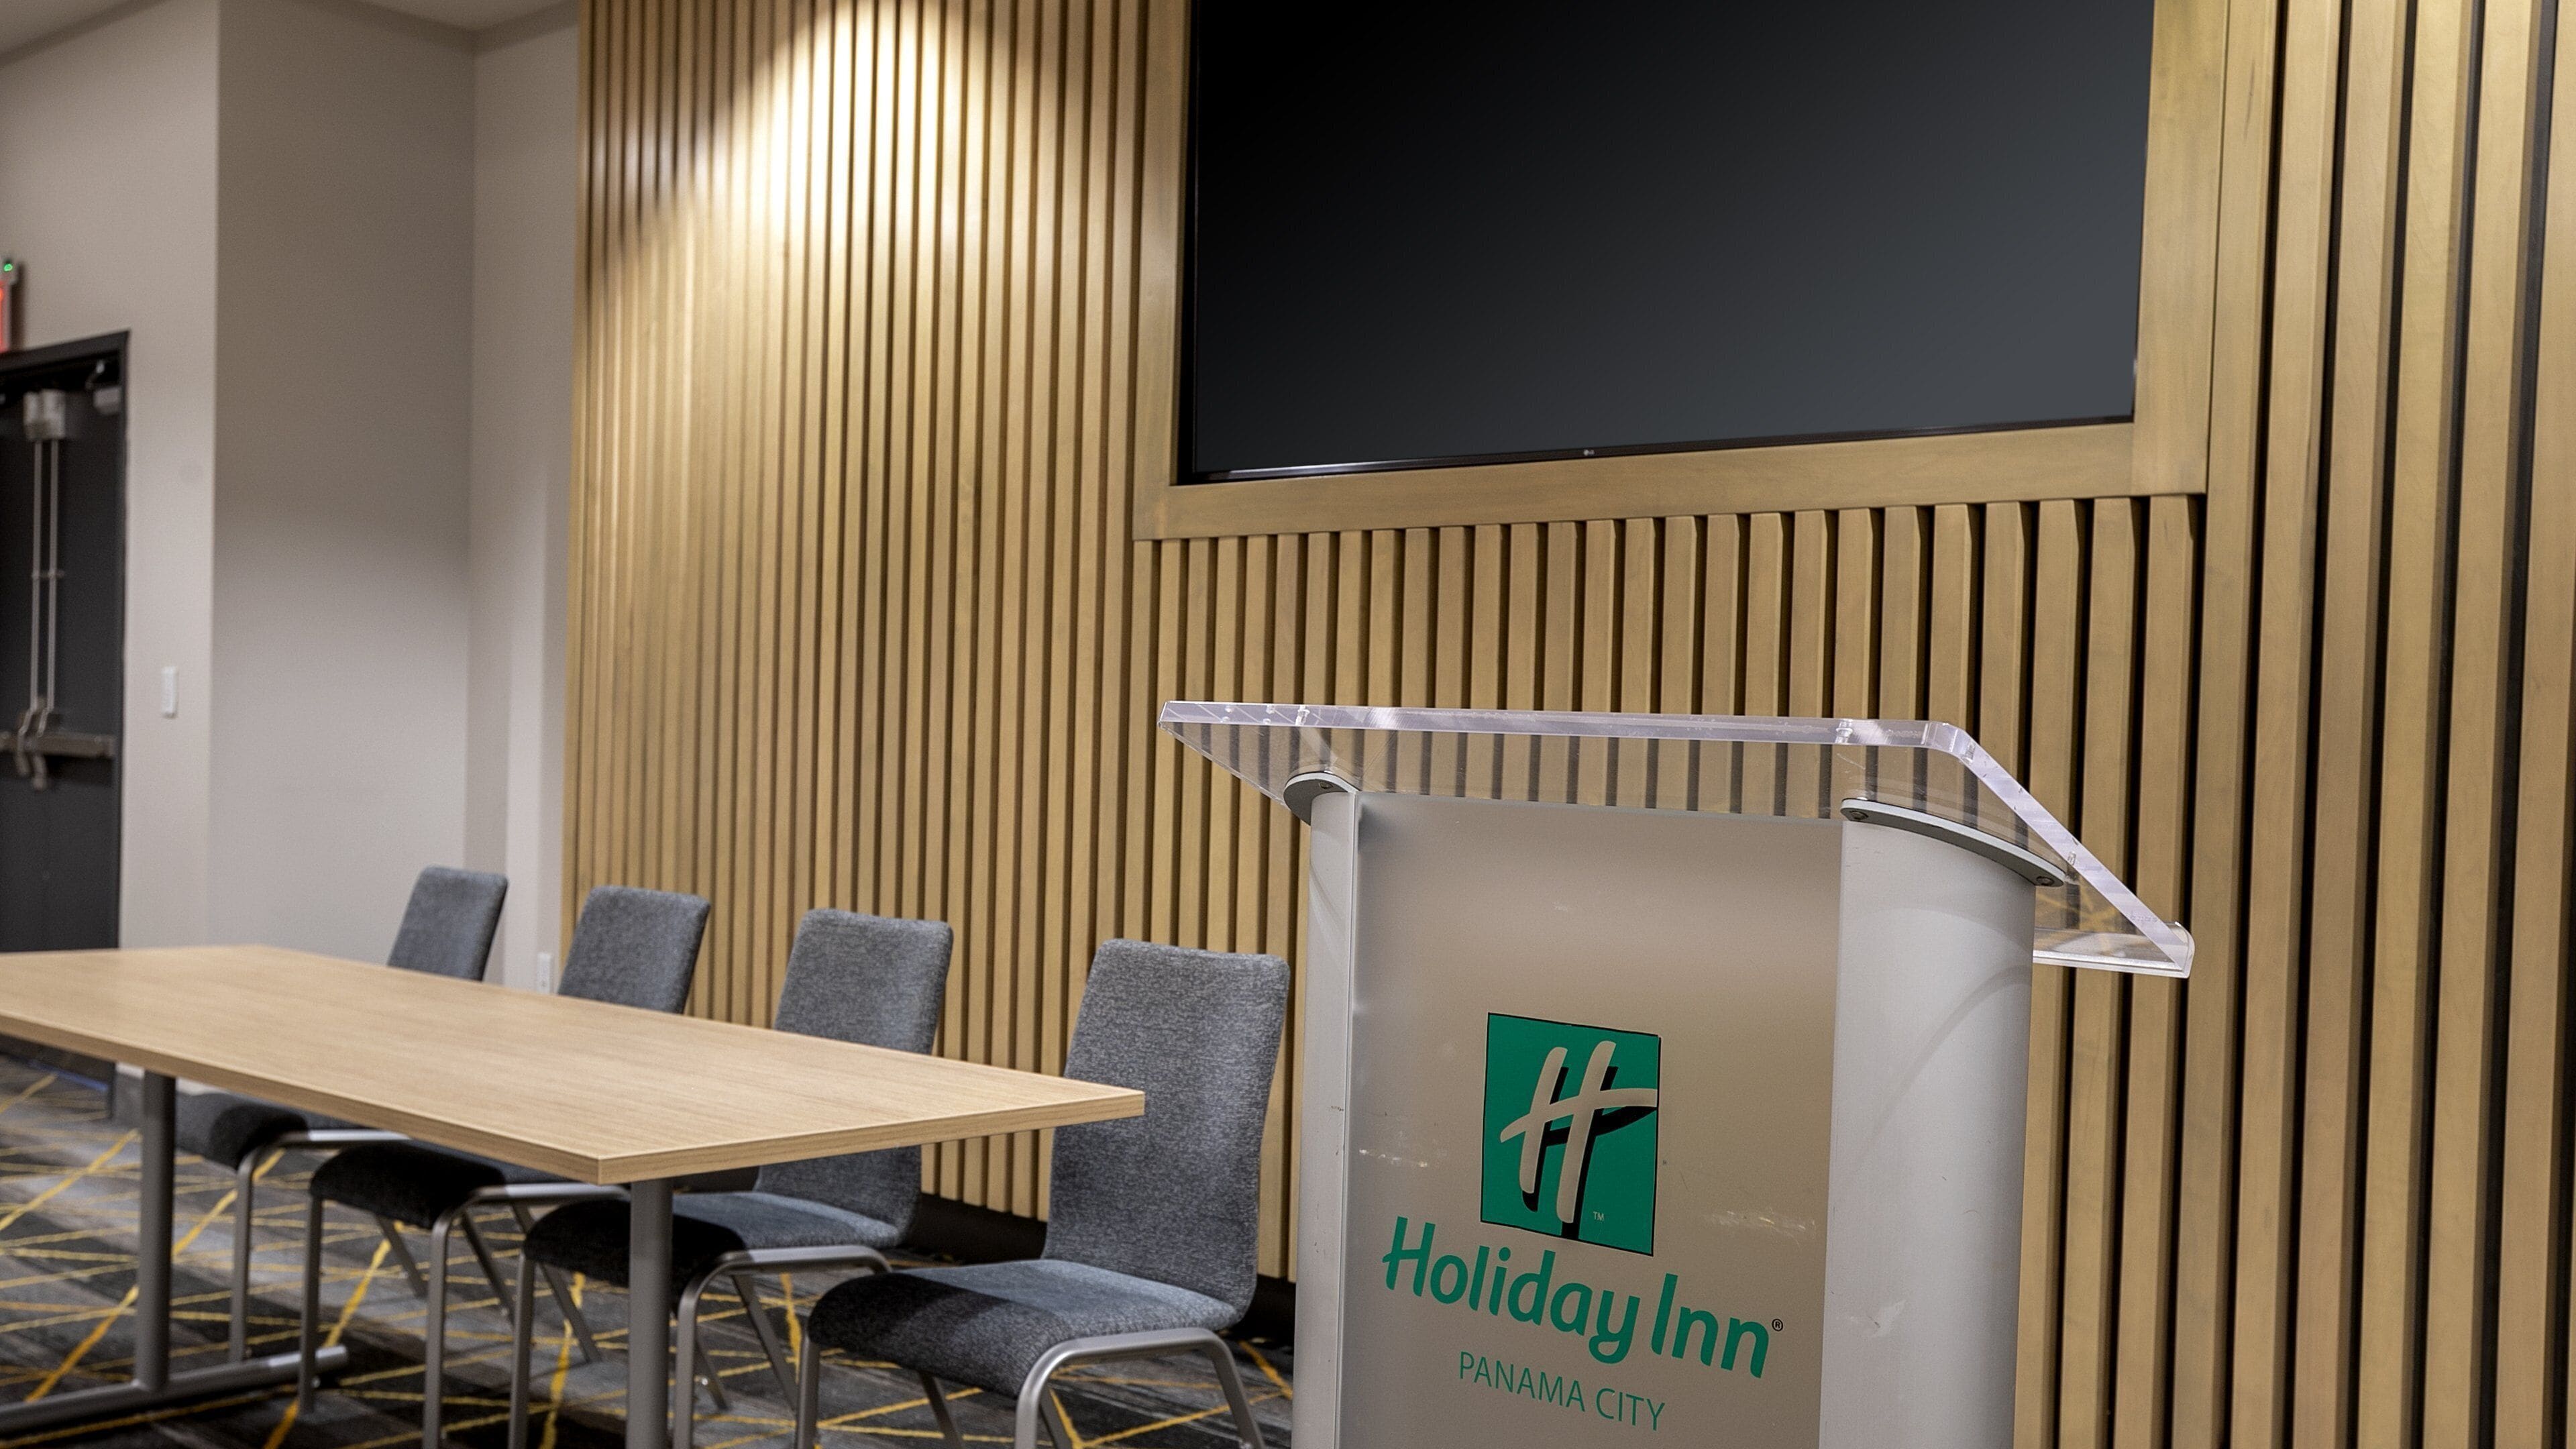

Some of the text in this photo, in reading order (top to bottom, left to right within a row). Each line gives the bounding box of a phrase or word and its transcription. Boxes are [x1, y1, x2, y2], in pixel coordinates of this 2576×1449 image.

[1382, 1216, 1640, 1364] Holiday
[1459, 1351, 1665, 1430] PANAMA CITY
